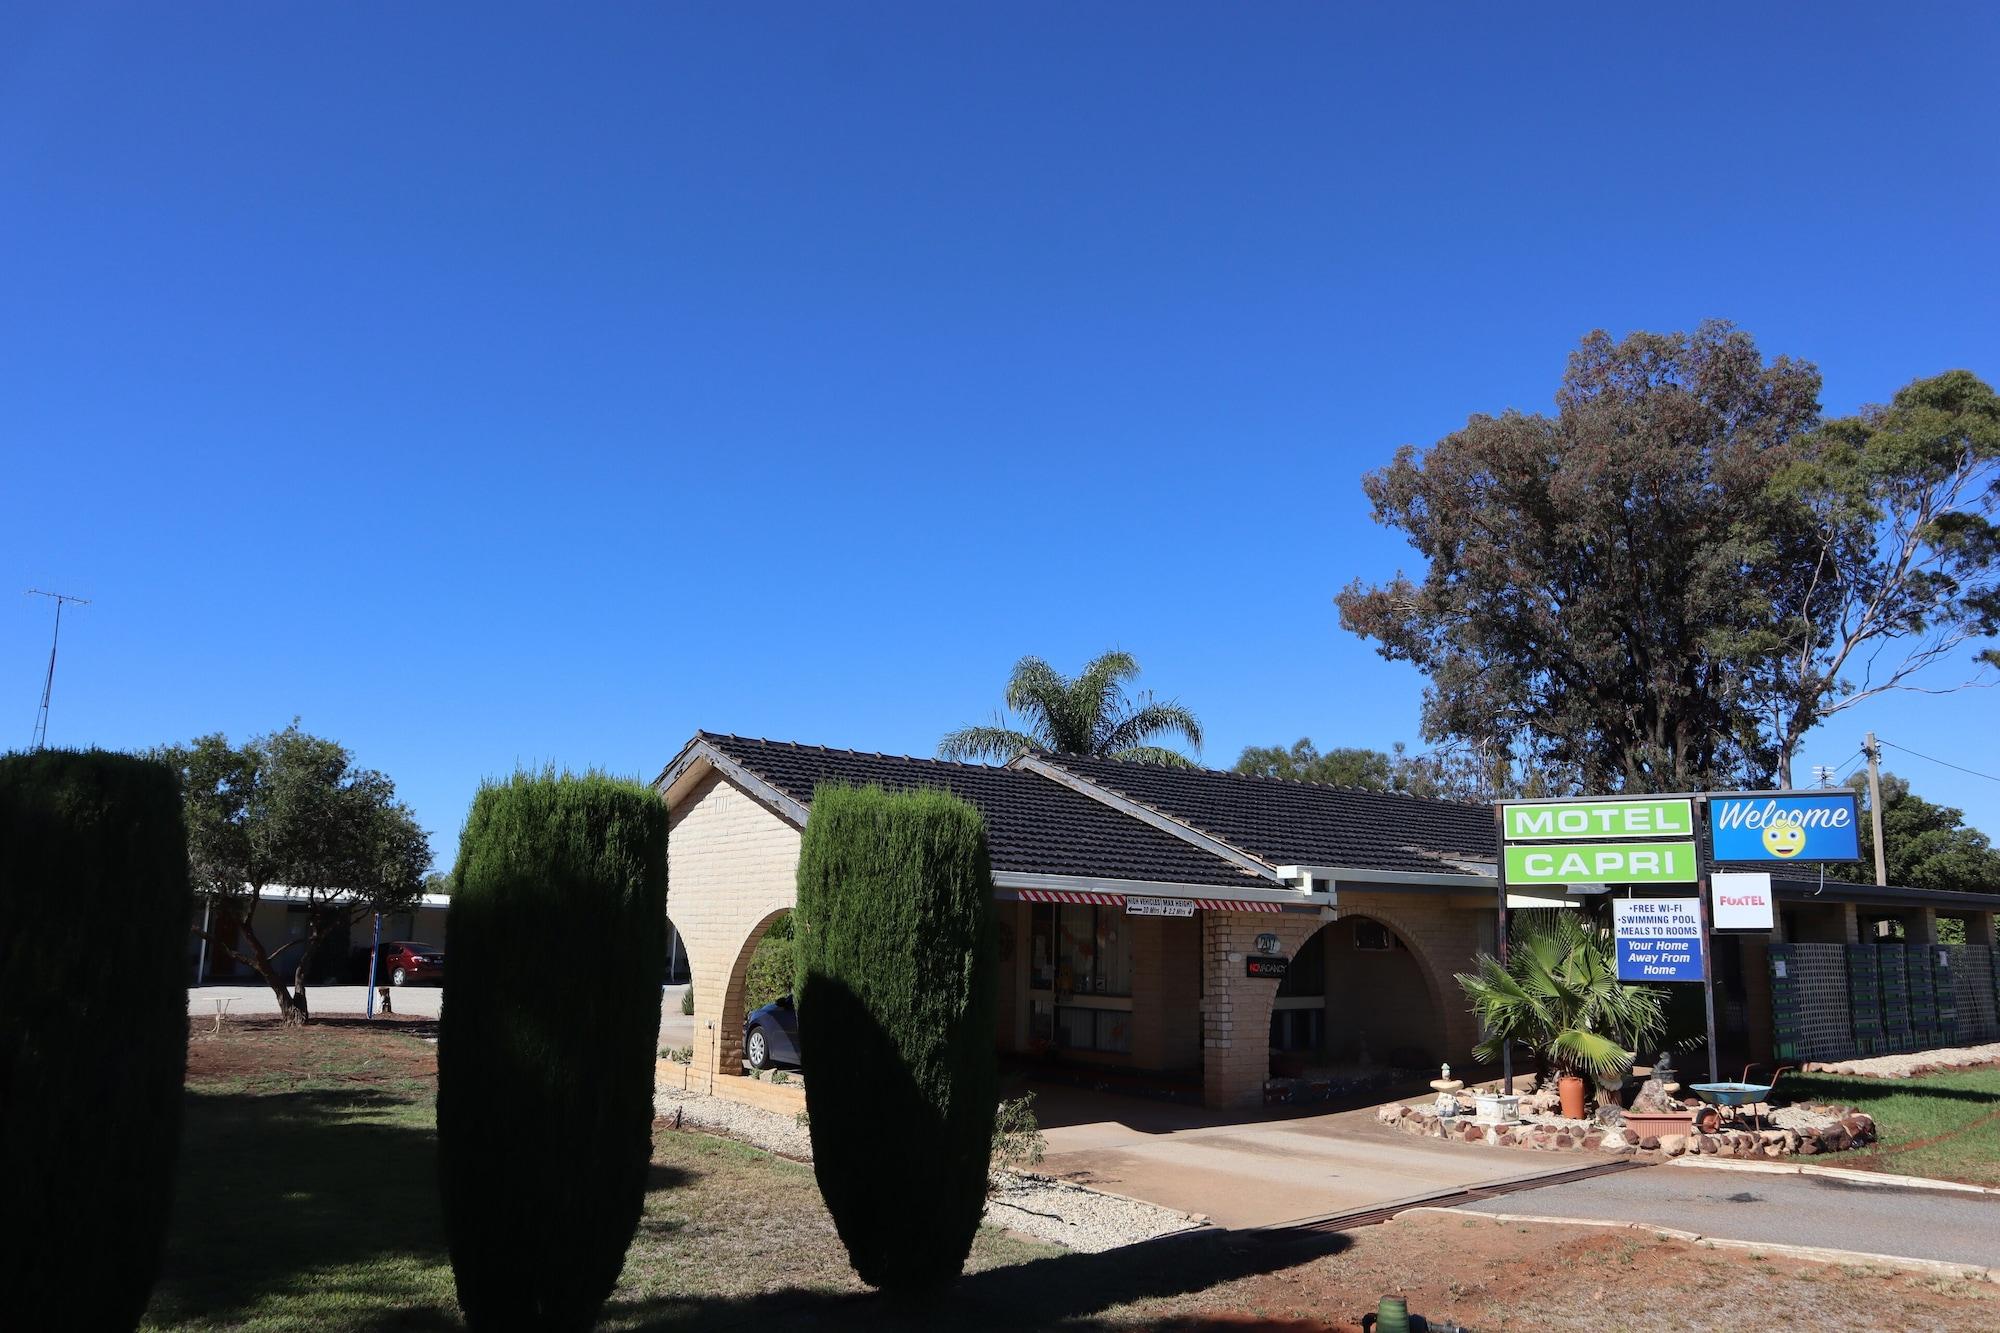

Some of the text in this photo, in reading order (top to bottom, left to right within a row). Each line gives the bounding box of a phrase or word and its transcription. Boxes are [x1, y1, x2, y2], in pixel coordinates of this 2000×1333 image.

[1719, 800, 1851, 830] Welcome
[1515, 808, 1681, 833] MOTEL
[1524, 851, 1674, 876] CAPRI
[1175, 900, 1193, 908] HEIGHT
[1633, 904, 1682, 913] FREE WI-FI
[1621, 915, 1696, 924] SWIMMING POOL
[1621, 927, 1698, 935] MEALS TO ROOMS
[1628, 941, 1689, 950] Your Home
[1628, 953, 1690, 964] Away From
[1250, 963, 1287, 973] NO VACANCY
[1643, 965, 1676, 975] Home
